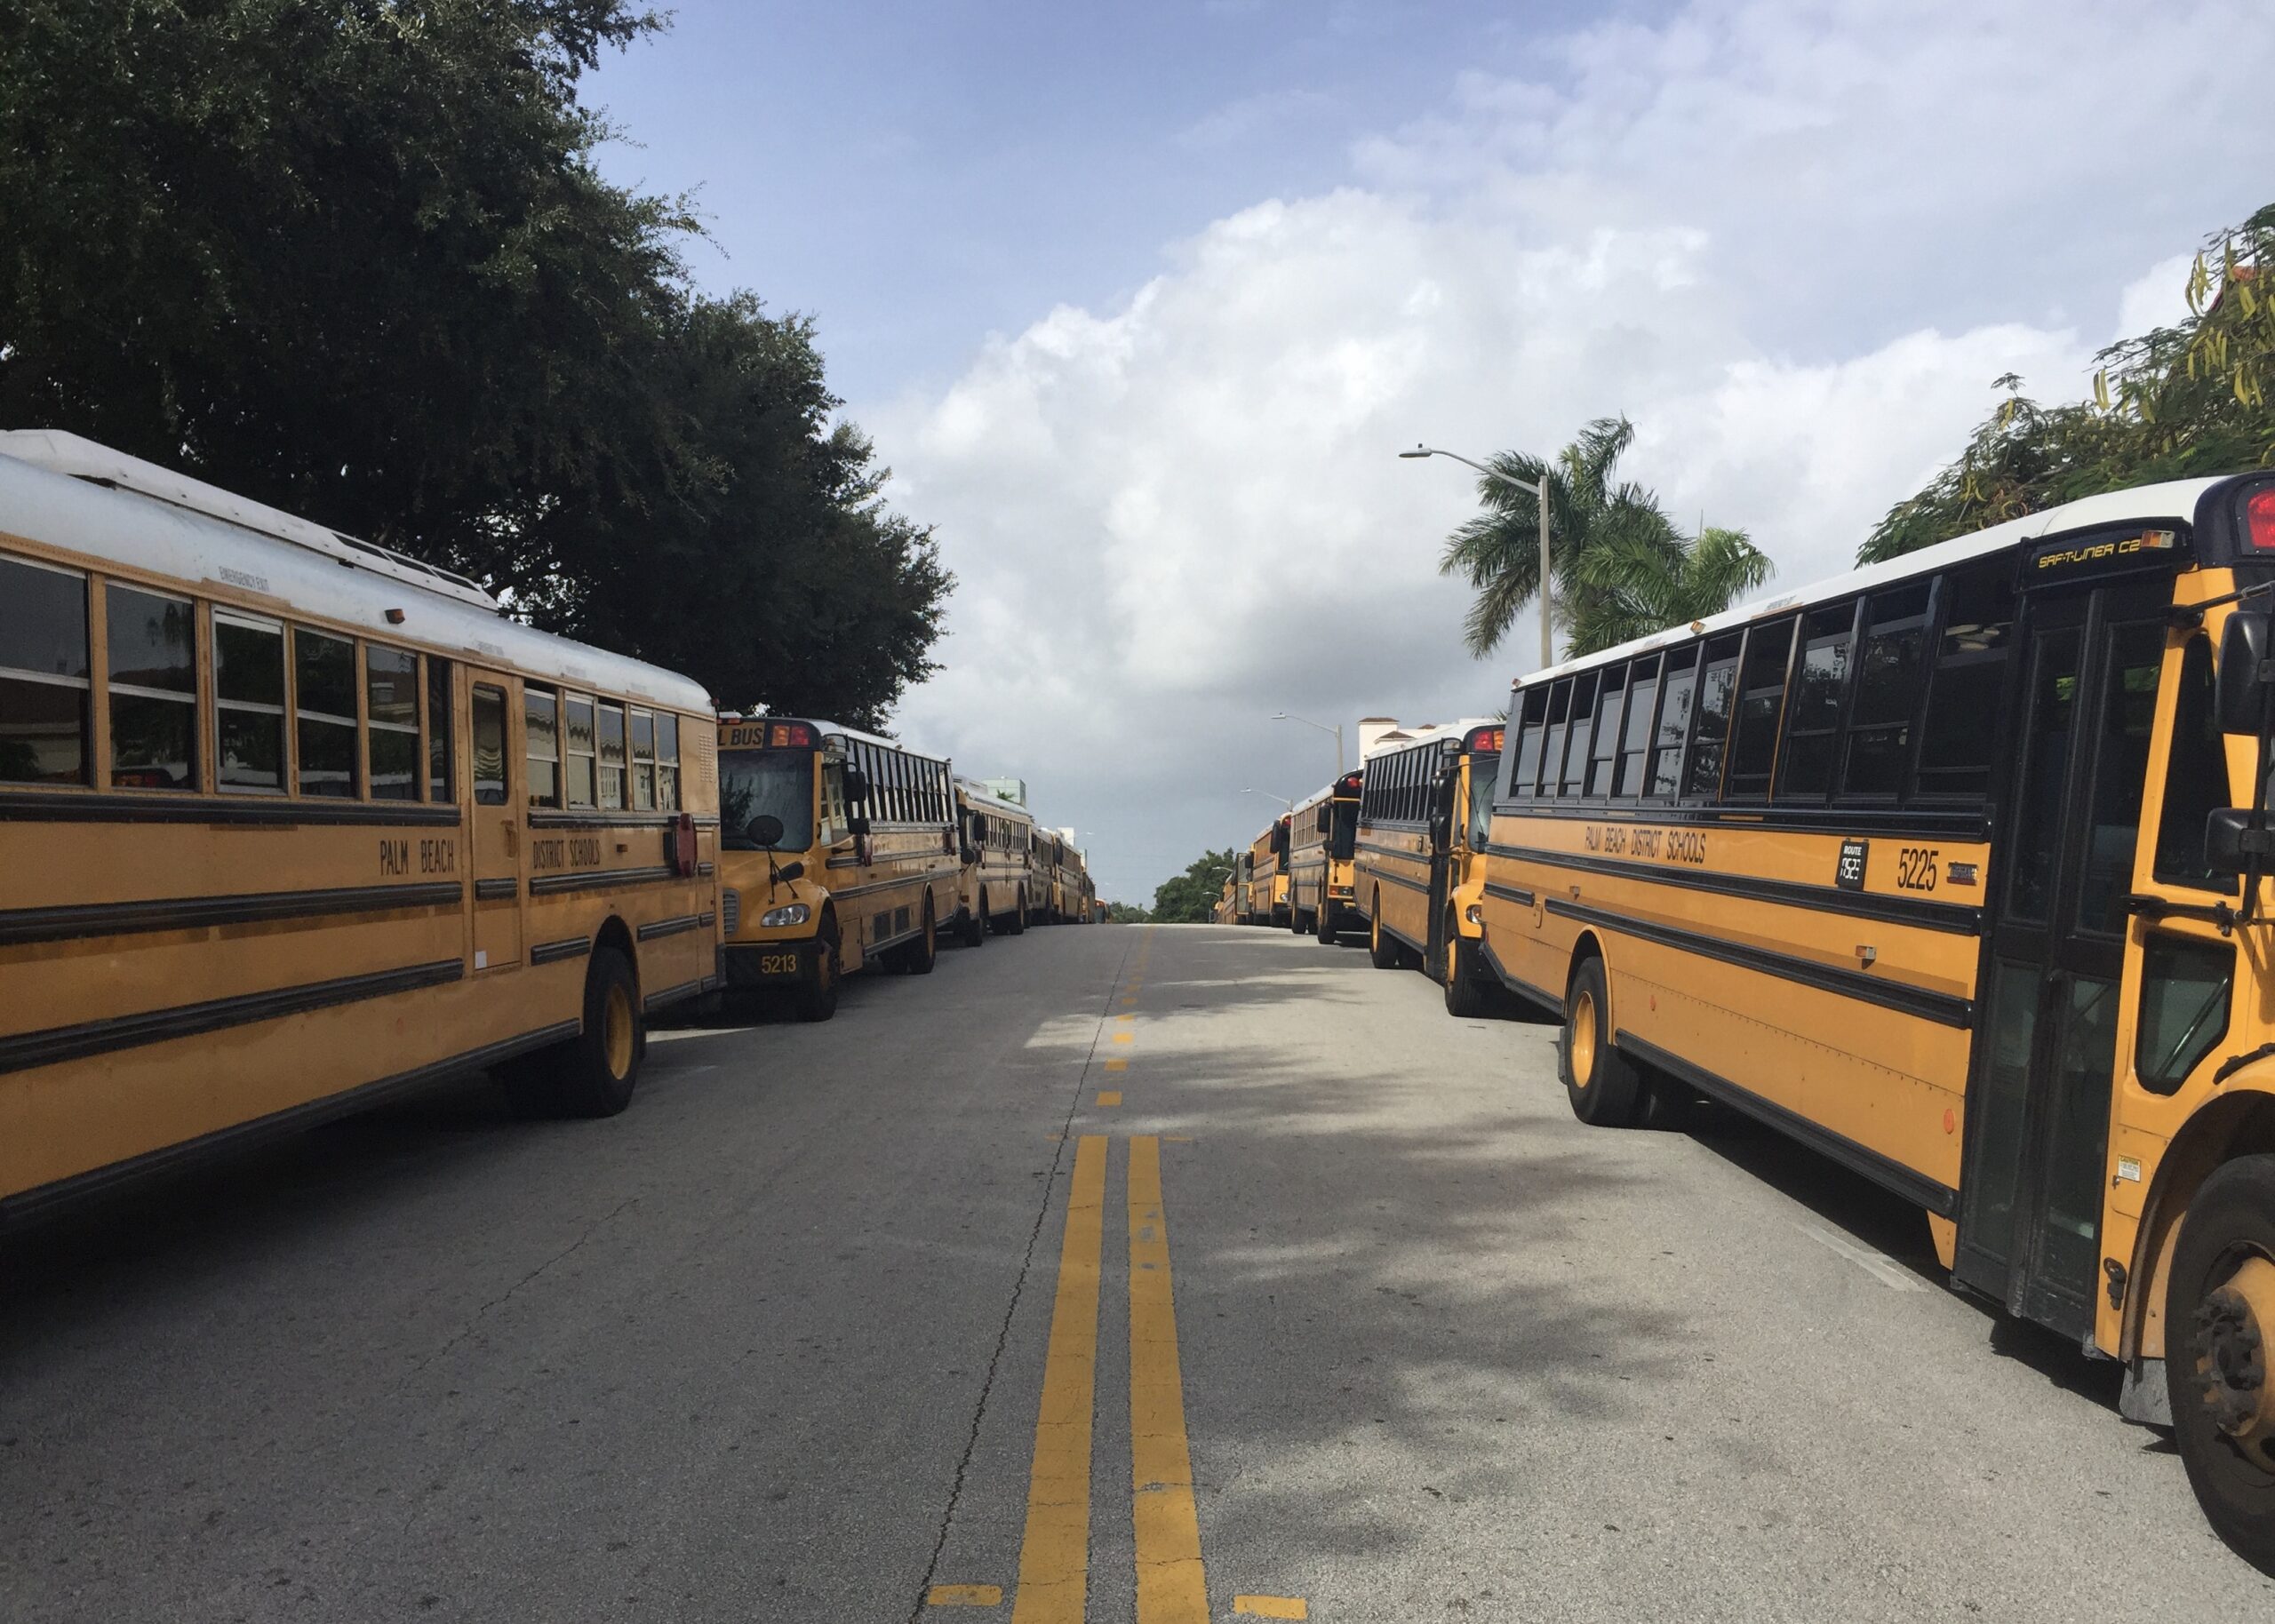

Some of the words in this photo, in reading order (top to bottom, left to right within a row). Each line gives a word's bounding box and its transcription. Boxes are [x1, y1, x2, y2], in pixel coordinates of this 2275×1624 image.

[2119, 538, 2142, 553] C2
[730, 727, 763, 746] BUS
[1585, 825, 1601, 851] PALM
[1604, 826, 1627, 854] BEACH
[1631, 828, 1663, 858] DISTRICT
[1666, 830, 1706, 864] SCHOOLS
[1844, 845, 1863, 856] ROUTE
[379, 840, 409, 876] PALM
[420, 839, 454, 874] BEACH
[533, 840, 564, 870] DISTRICT
[569, 839, 601, 868] SCHOOLS
[1897, 848, 1939, 892] 5225
[761, 954, 797, 974] 5213
